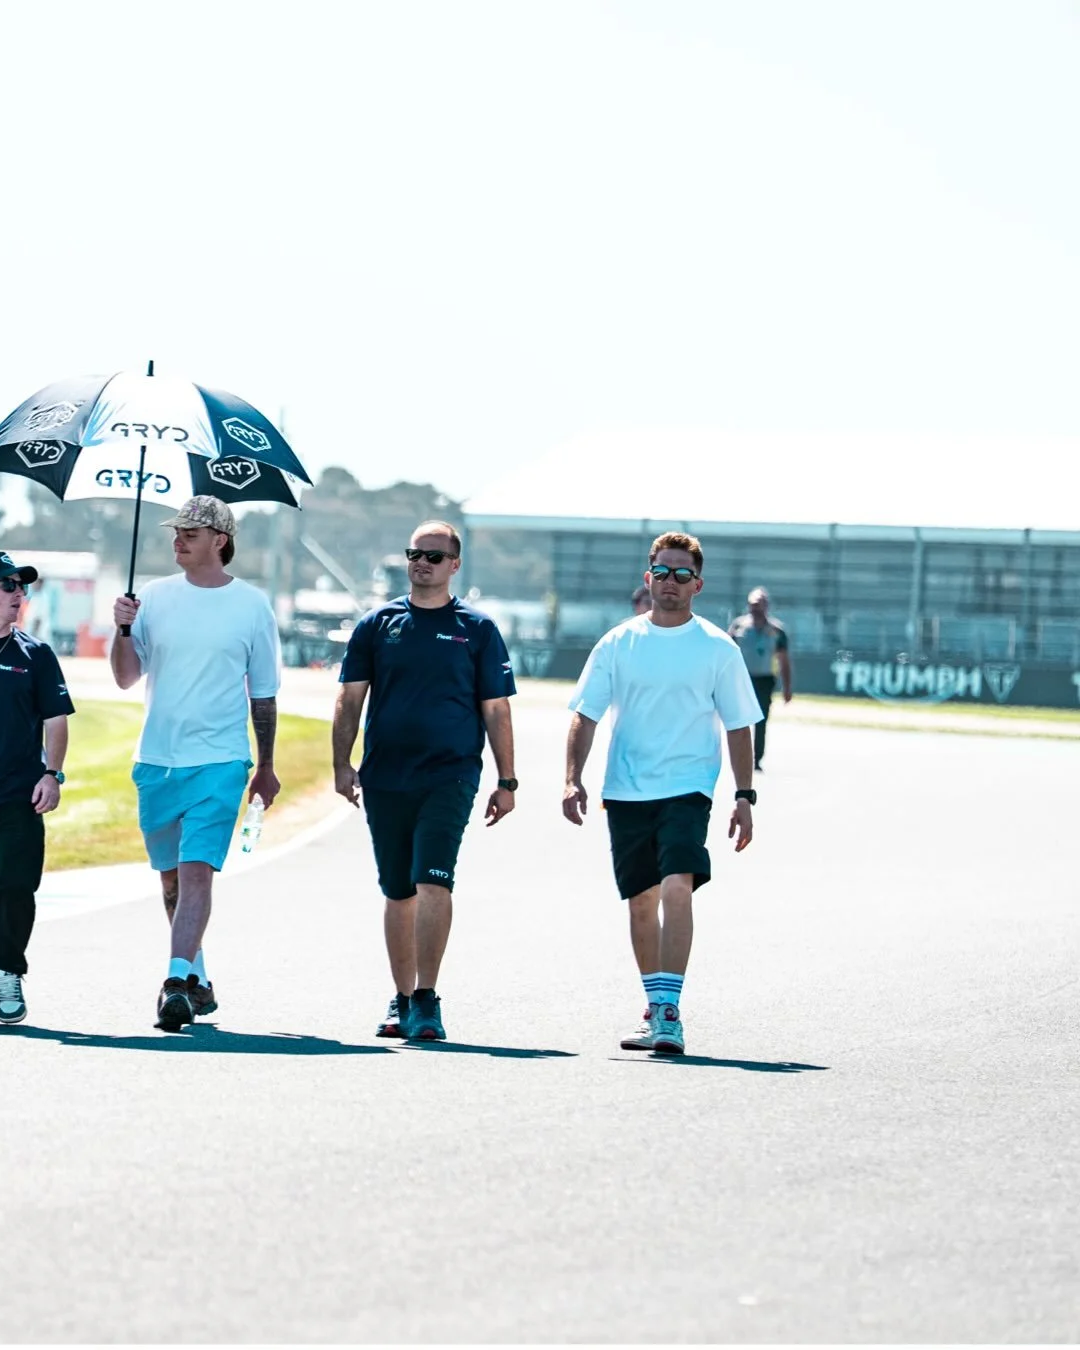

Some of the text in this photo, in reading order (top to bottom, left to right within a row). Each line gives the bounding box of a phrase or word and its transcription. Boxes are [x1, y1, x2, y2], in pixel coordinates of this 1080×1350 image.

[111, 422, 189, 442] GRYD
[213, 461, 254, 476] GRYD
[96, 469, 171, 493] GRYD
[830, 660, 983, 706] TRIUMPH
